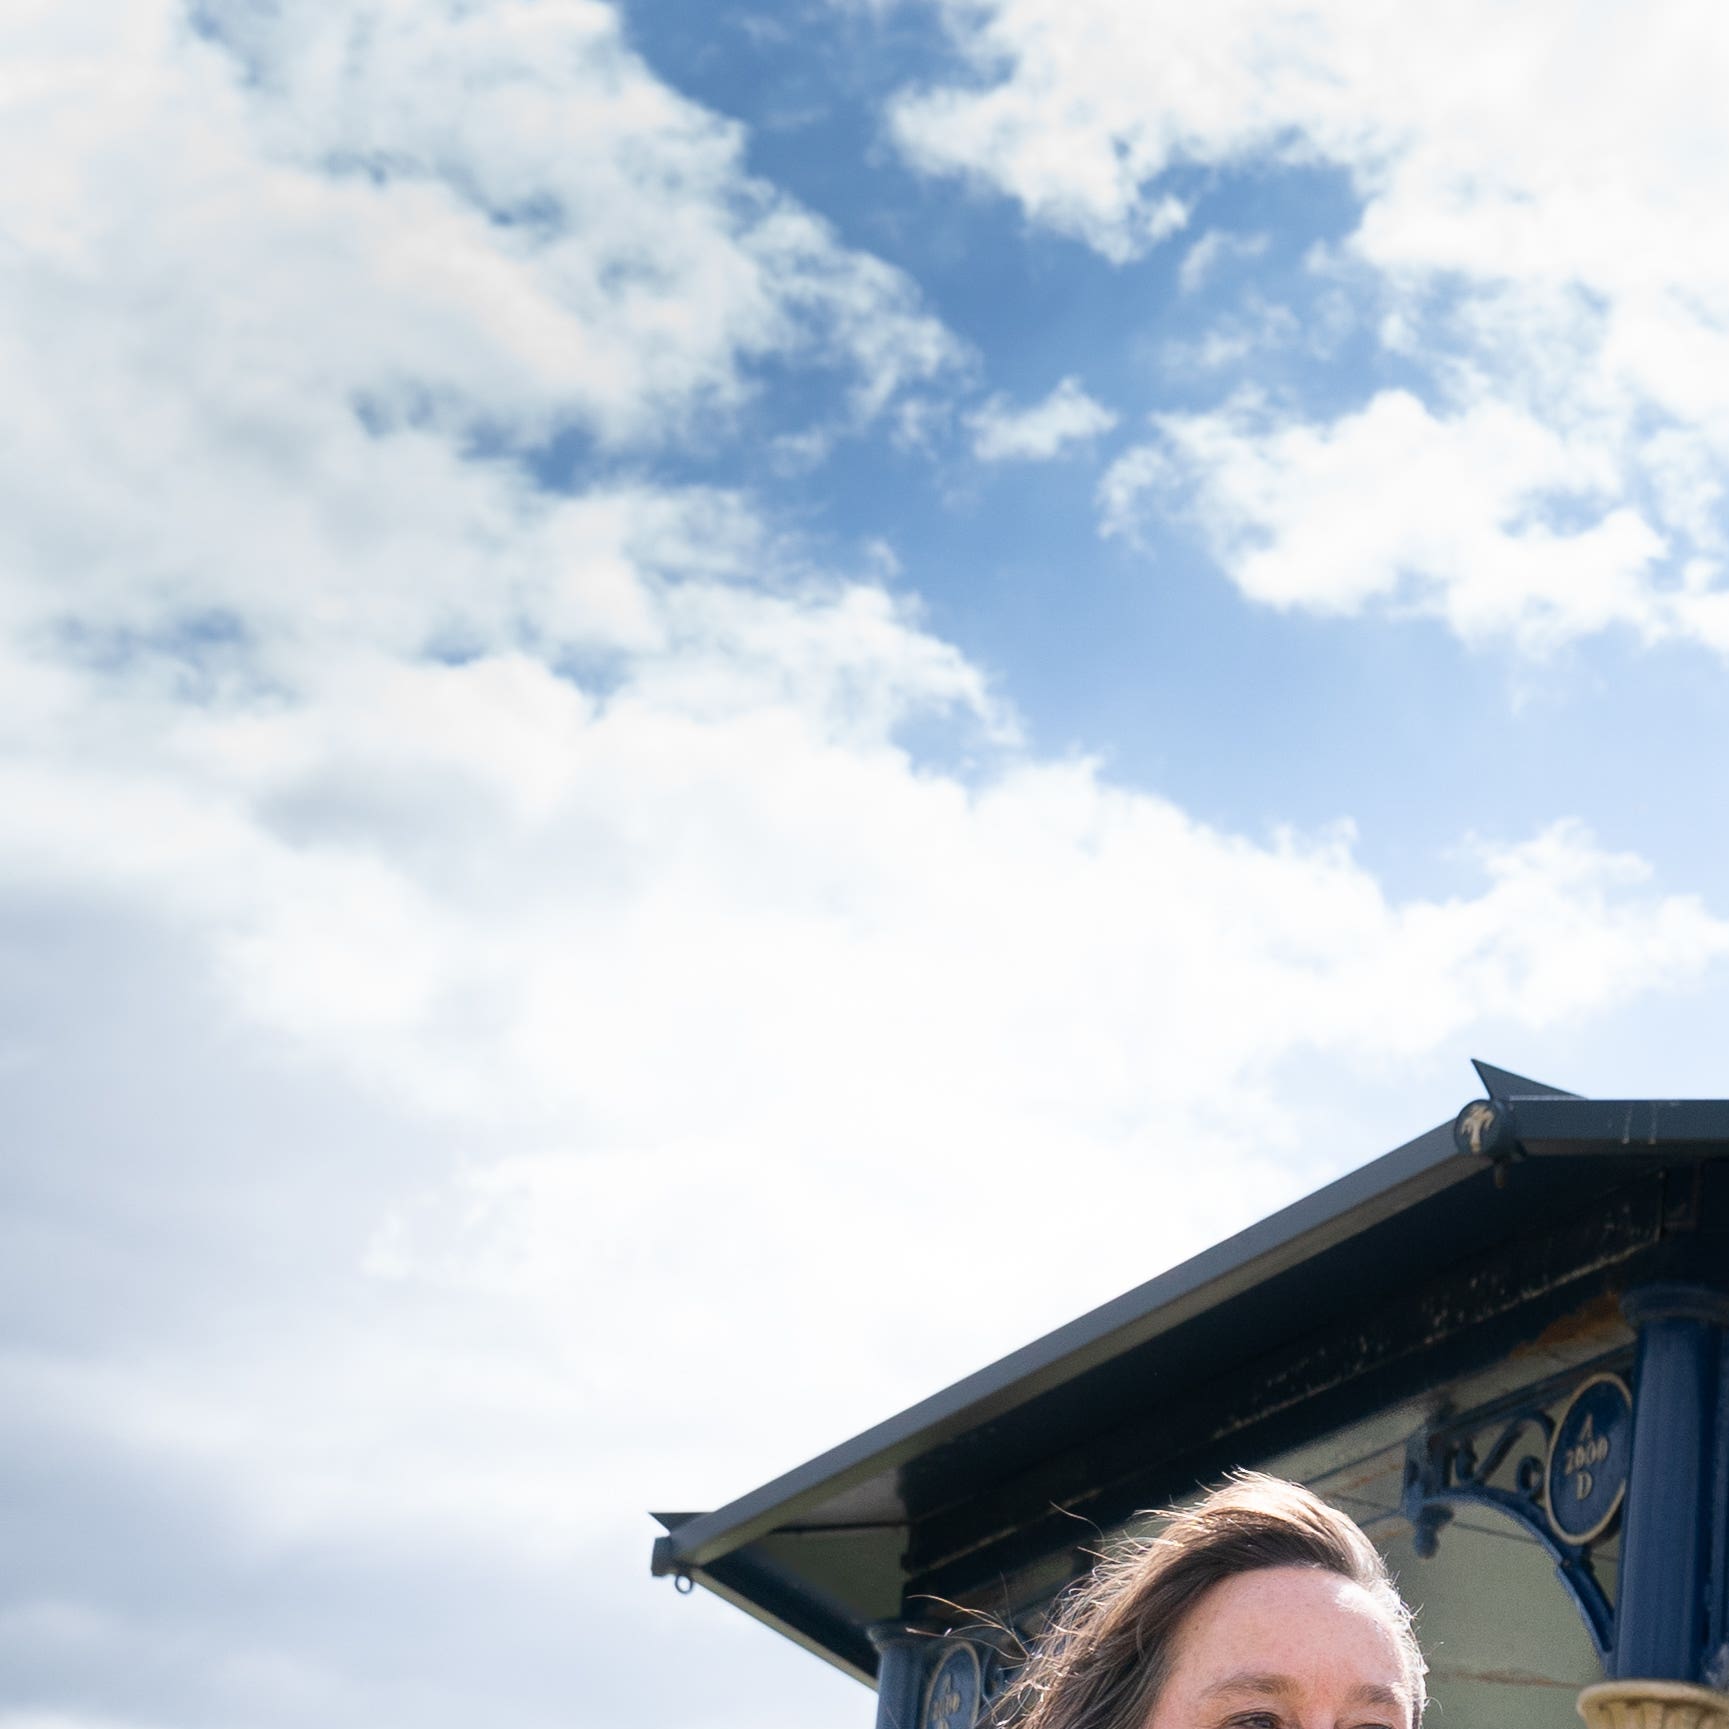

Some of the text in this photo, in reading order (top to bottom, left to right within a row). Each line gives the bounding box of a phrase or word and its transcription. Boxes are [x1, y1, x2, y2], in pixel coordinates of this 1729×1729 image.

[1578, 1412, 1594, 1443] A
[1565, 1435, 1610, 1476] 2000
[1576, 1471, 1593, 1500] D
